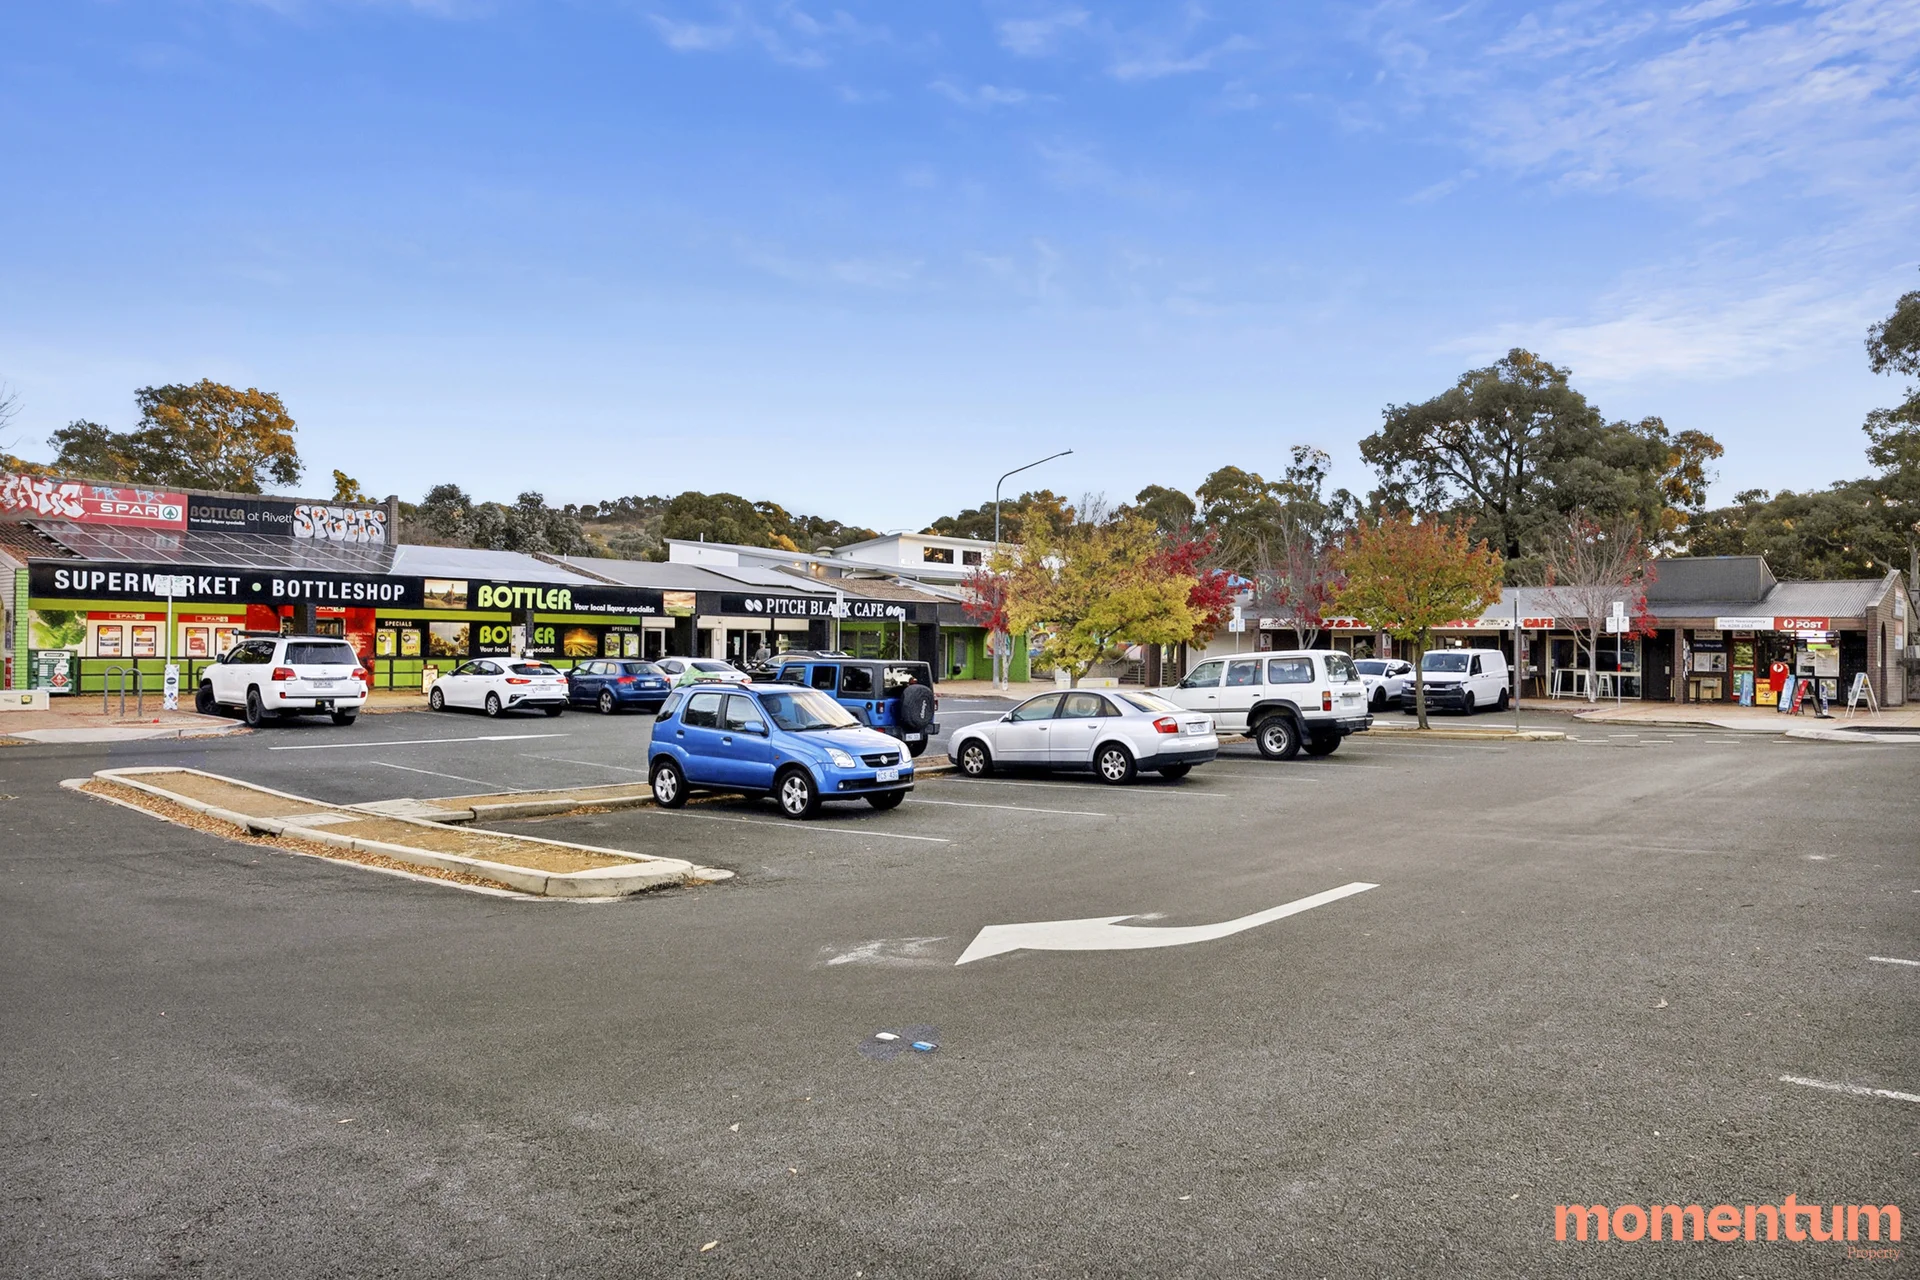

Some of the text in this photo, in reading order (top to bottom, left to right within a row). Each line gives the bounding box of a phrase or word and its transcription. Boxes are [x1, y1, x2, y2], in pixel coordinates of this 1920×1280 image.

[100, 503, 158, 516] SPAR
[190, 506, 292, 523] BOTTLER at Rivett
[54, 570, 405, 601] SUPERMRKET BOTTLESHOP
[478, 585, 655, 614] BOTTLER Your local liquor specialist
[766, 598, 884, 617] PITCH BLAK CAFE
[1523, 618, 1554, 628] CAFE
